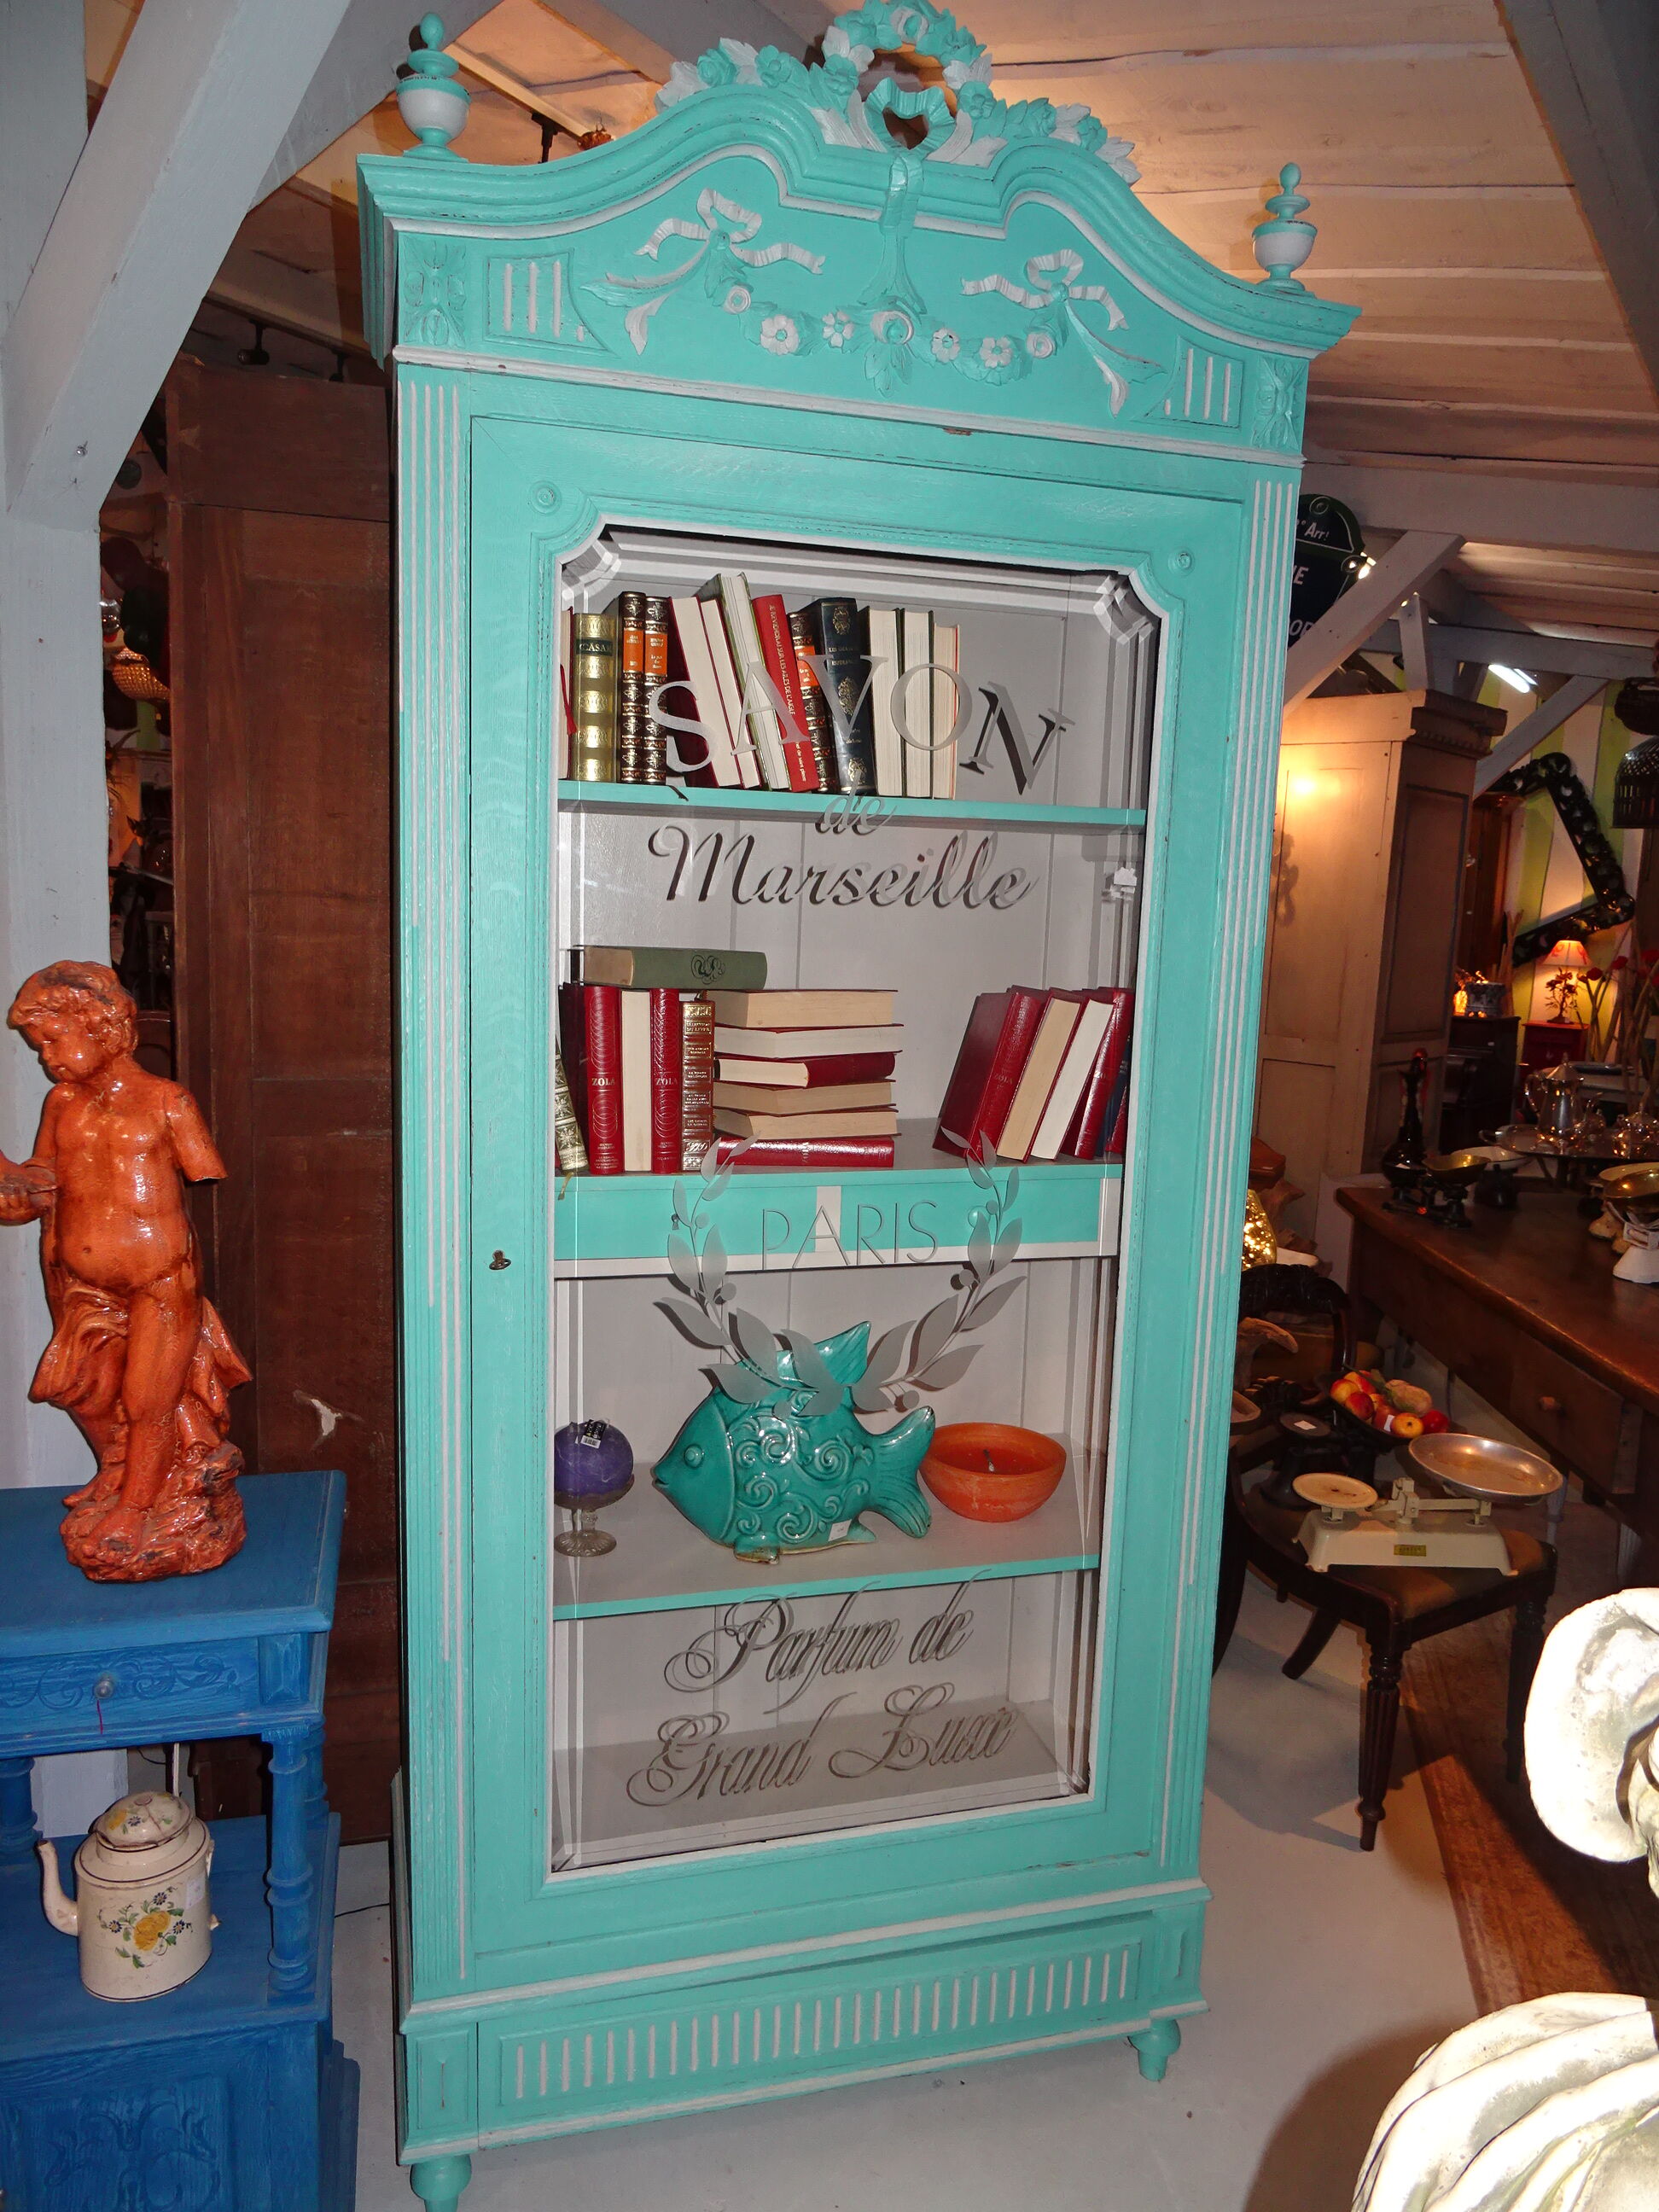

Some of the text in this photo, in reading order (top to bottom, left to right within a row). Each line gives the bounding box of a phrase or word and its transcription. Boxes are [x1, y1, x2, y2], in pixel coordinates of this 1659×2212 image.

[649, 655, 1077, 789] SAVON
[819, 762, 898, 833] de
[648, 820, 1039, 910] Marseille
[591, 1078, 614, 1086] ZOLA
[655, 1077, 678, 1086] ZOLA
[762, 1200, 939, 1271] PARIS
[664, 1569, 991, 1714] Parfum de
[626, 1691, 858, 1807] Grand
